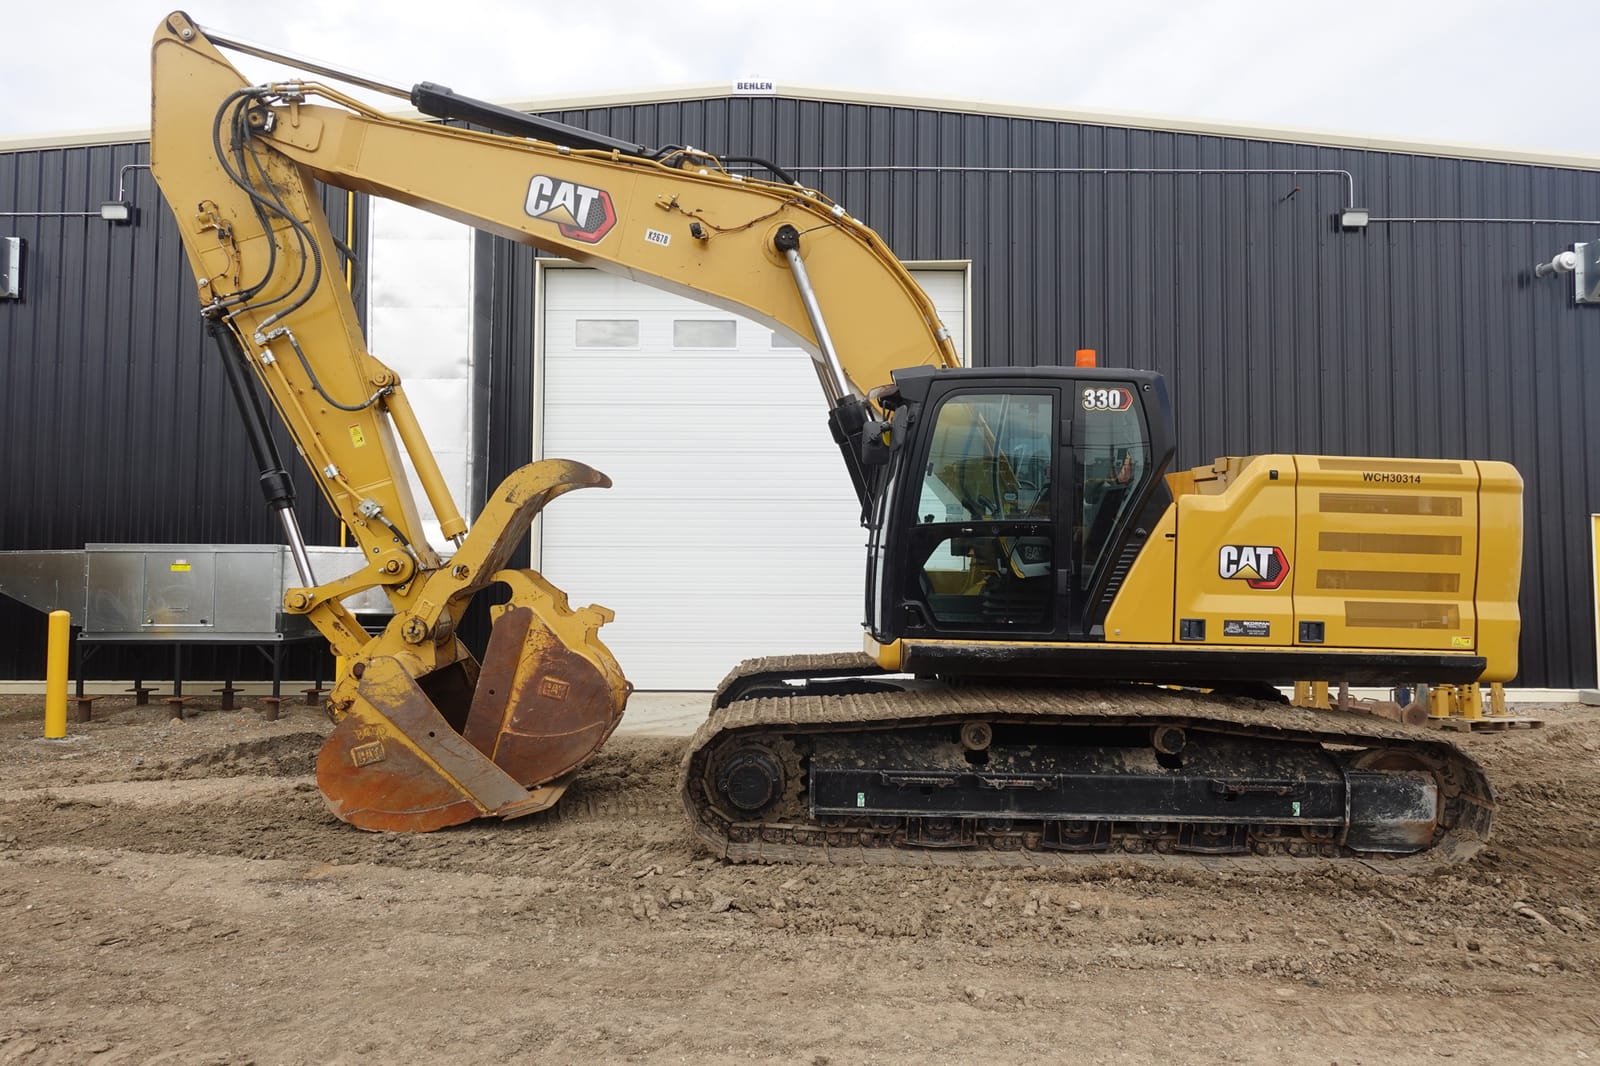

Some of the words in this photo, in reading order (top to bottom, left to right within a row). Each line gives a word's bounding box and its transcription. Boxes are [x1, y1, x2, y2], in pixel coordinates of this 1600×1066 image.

[737, 82, 772, 90] BEHLEN
[525, 175, 600, 229] CAT
[1084, 389, 1121, 409] 330
[1363, 471, 1421, 484] WCH30314
[1220, 545, 1274, 580] CAT
